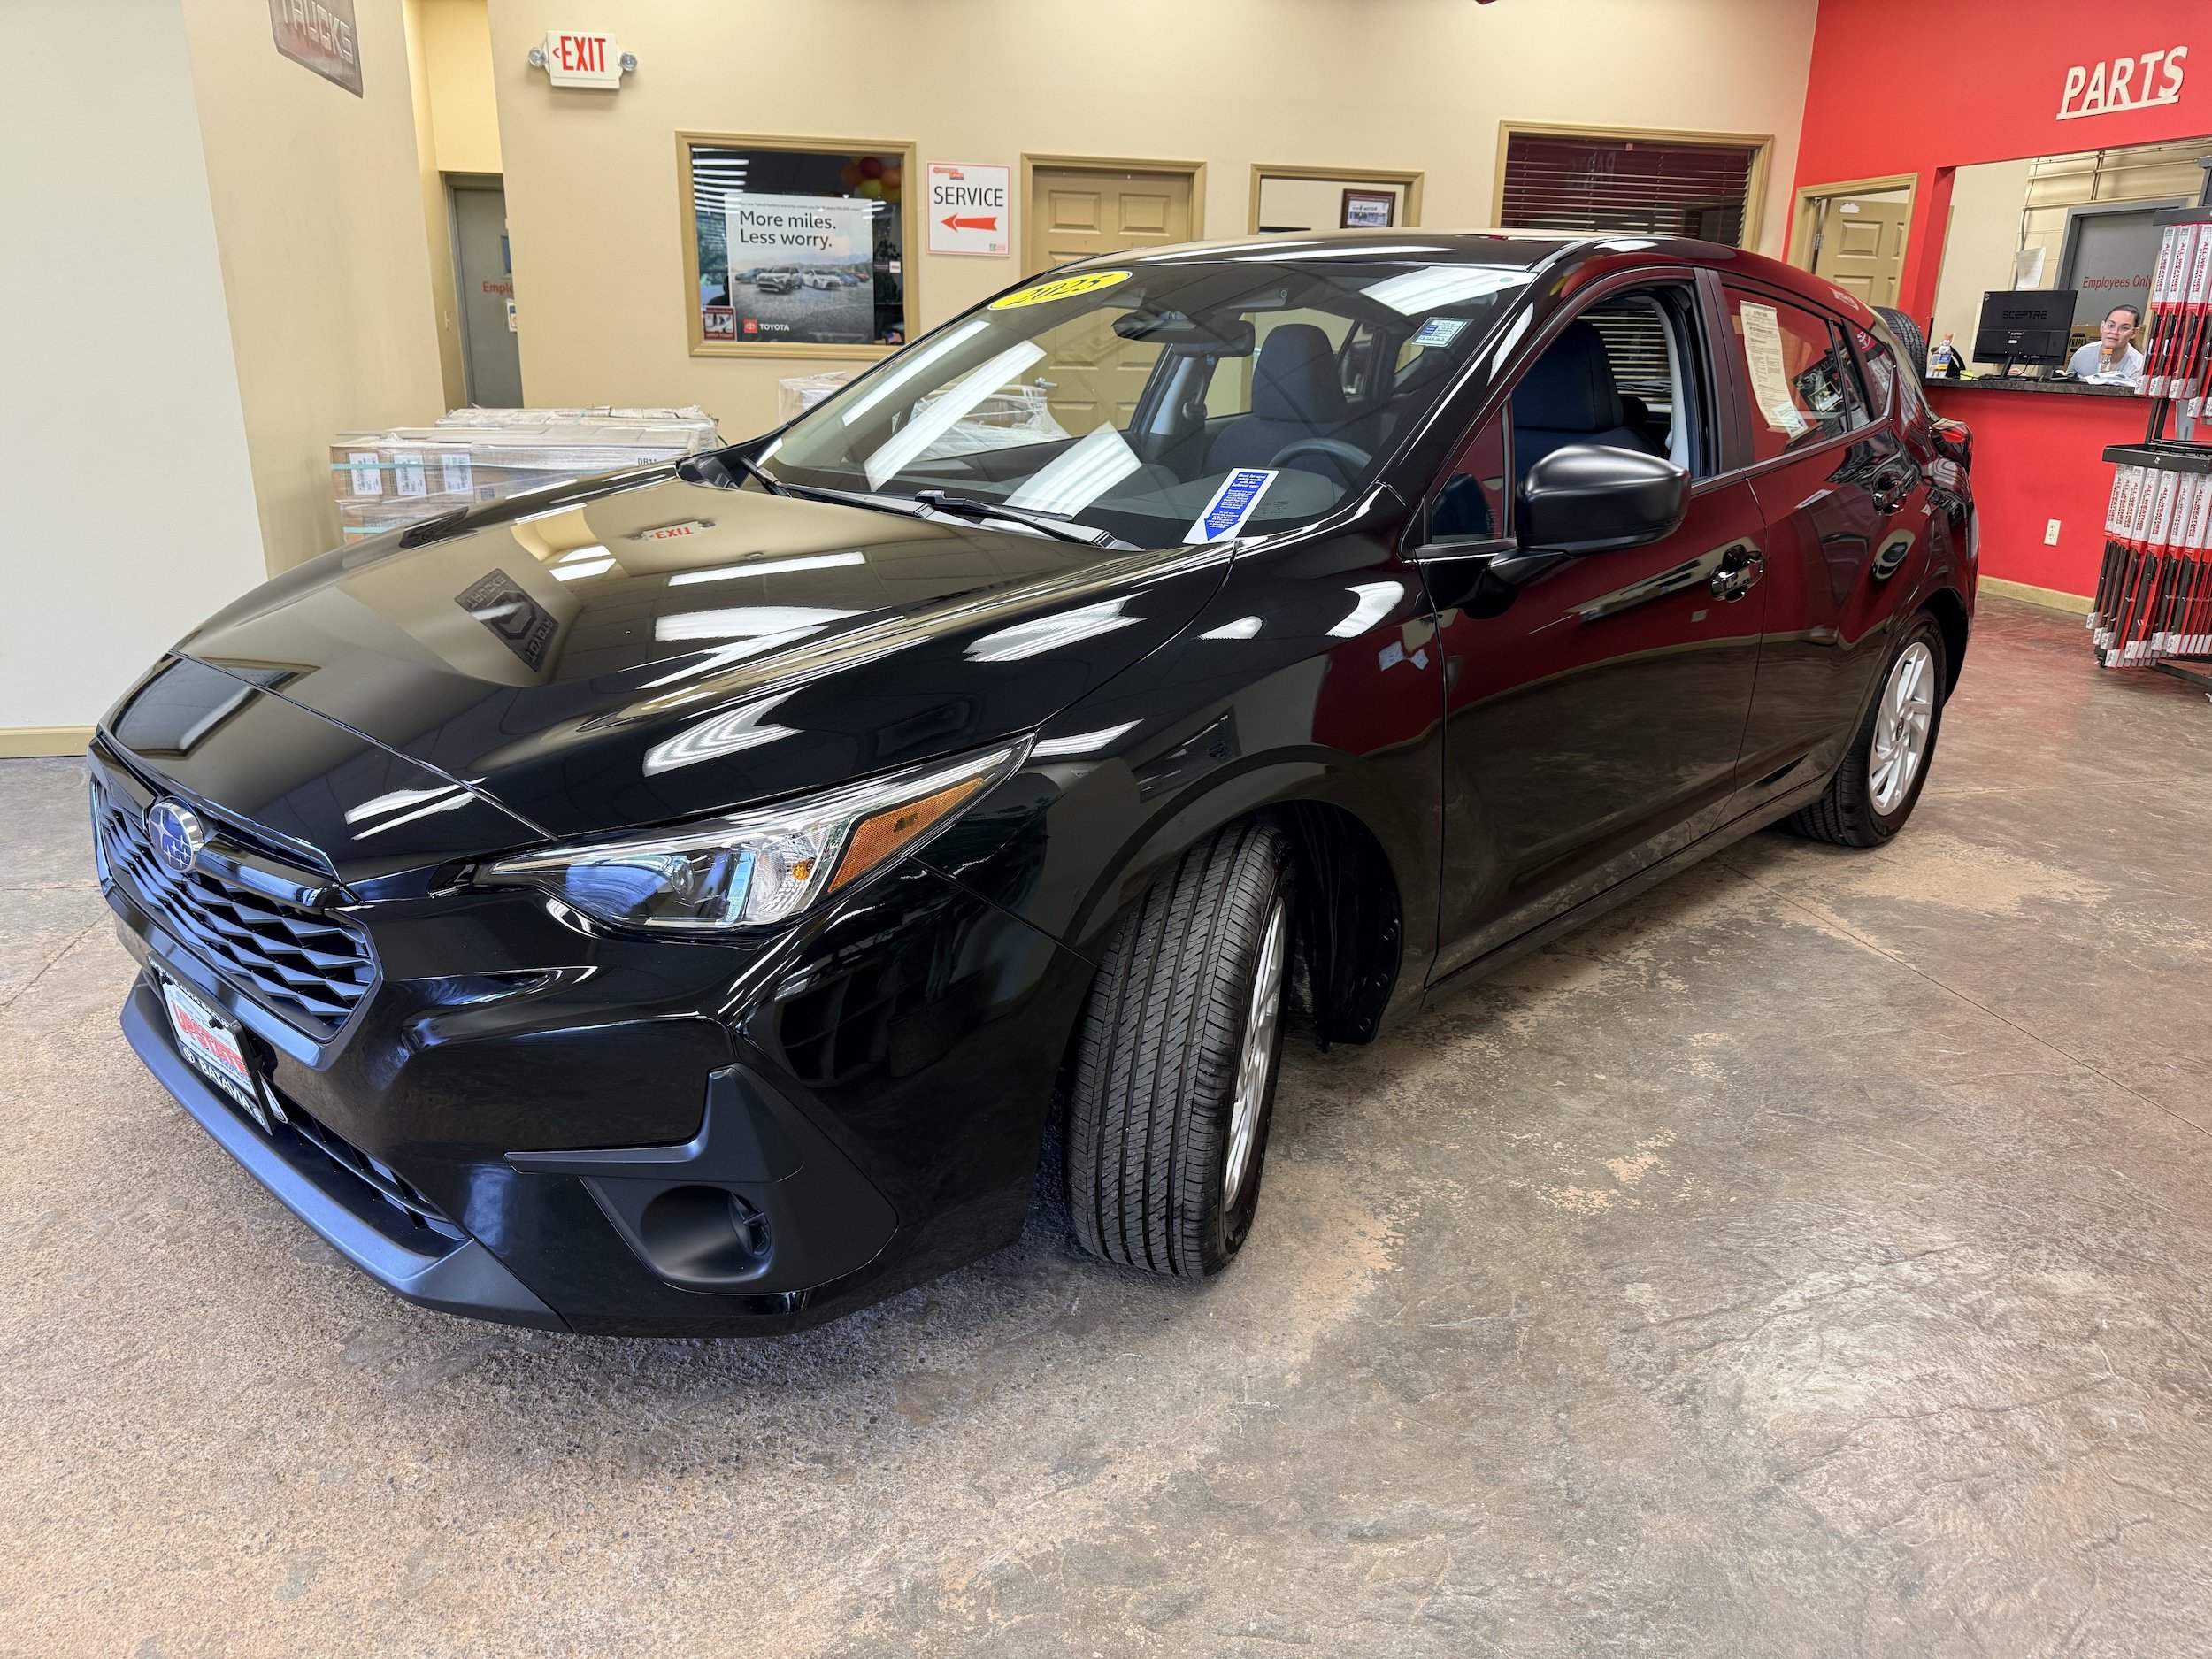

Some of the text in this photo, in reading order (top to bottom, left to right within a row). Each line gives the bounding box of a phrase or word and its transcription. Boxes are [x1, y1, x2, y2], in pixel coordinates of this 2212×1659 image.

[560, 35, 606, 72] EXIT
[2059, 45, 2189, 117] PARTS
[933, 186, 1004, 207] SERVICE
[740, 210, 836, 229] More miles.
[740, 228, 833, 250] Less worry.
[2195, 242, 2208, 293] ALL-WEATHER
[2083, 274, 2152, 290] Employees Only
[2002, 311, 2047, 319] SCEPTRE
[759, 323, 790, 332] TOYOTA
[198, 1057, 254, 1115] BATAVIA
